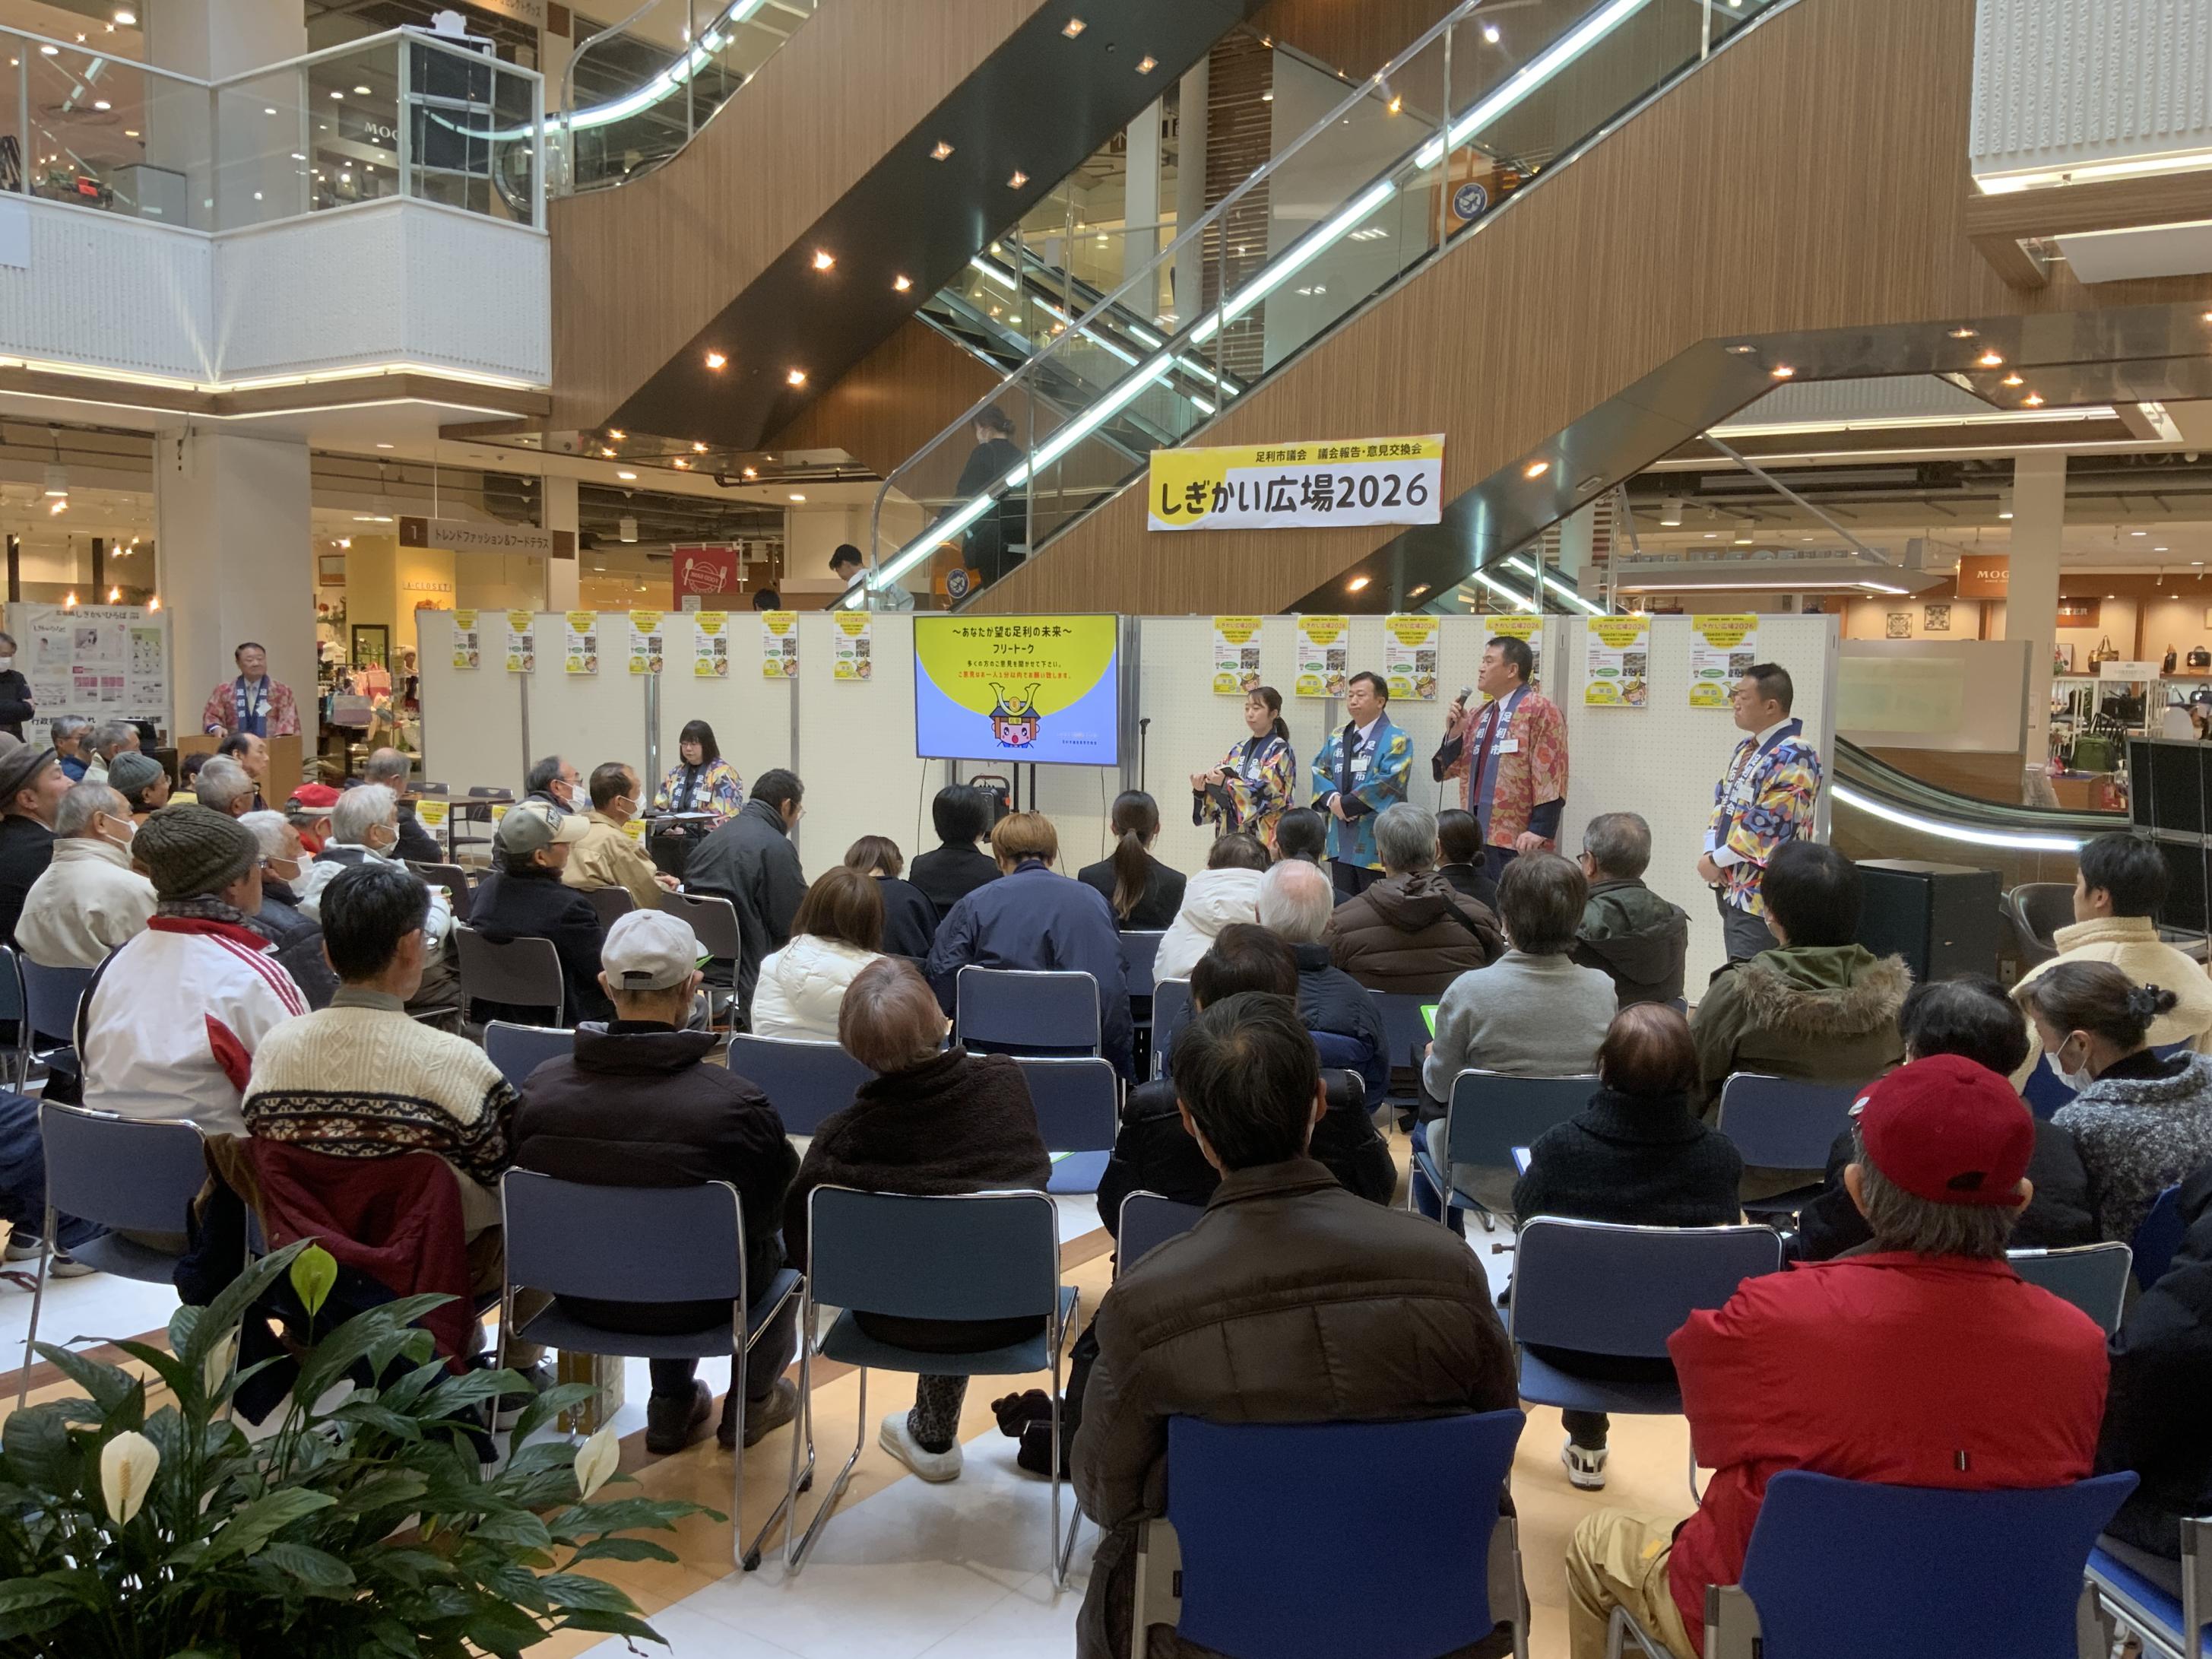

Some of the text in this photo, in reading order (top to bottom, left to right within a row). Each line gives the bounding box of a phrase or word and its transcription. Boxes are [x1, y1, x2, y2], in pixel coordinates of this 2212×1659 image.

[1256, 443, 1422, 463] 足利市議会 議会報告・意見交換会
[1161, 472, 1428, 515] しぎかい広場2026
[411, 525, 417, 541] 1
[436, 528, 549, 549] トレンドファッション&フードテラス
[993, 644, 1035, 654] フリートーク
[1491, 712, 1513, 755] 足利市
